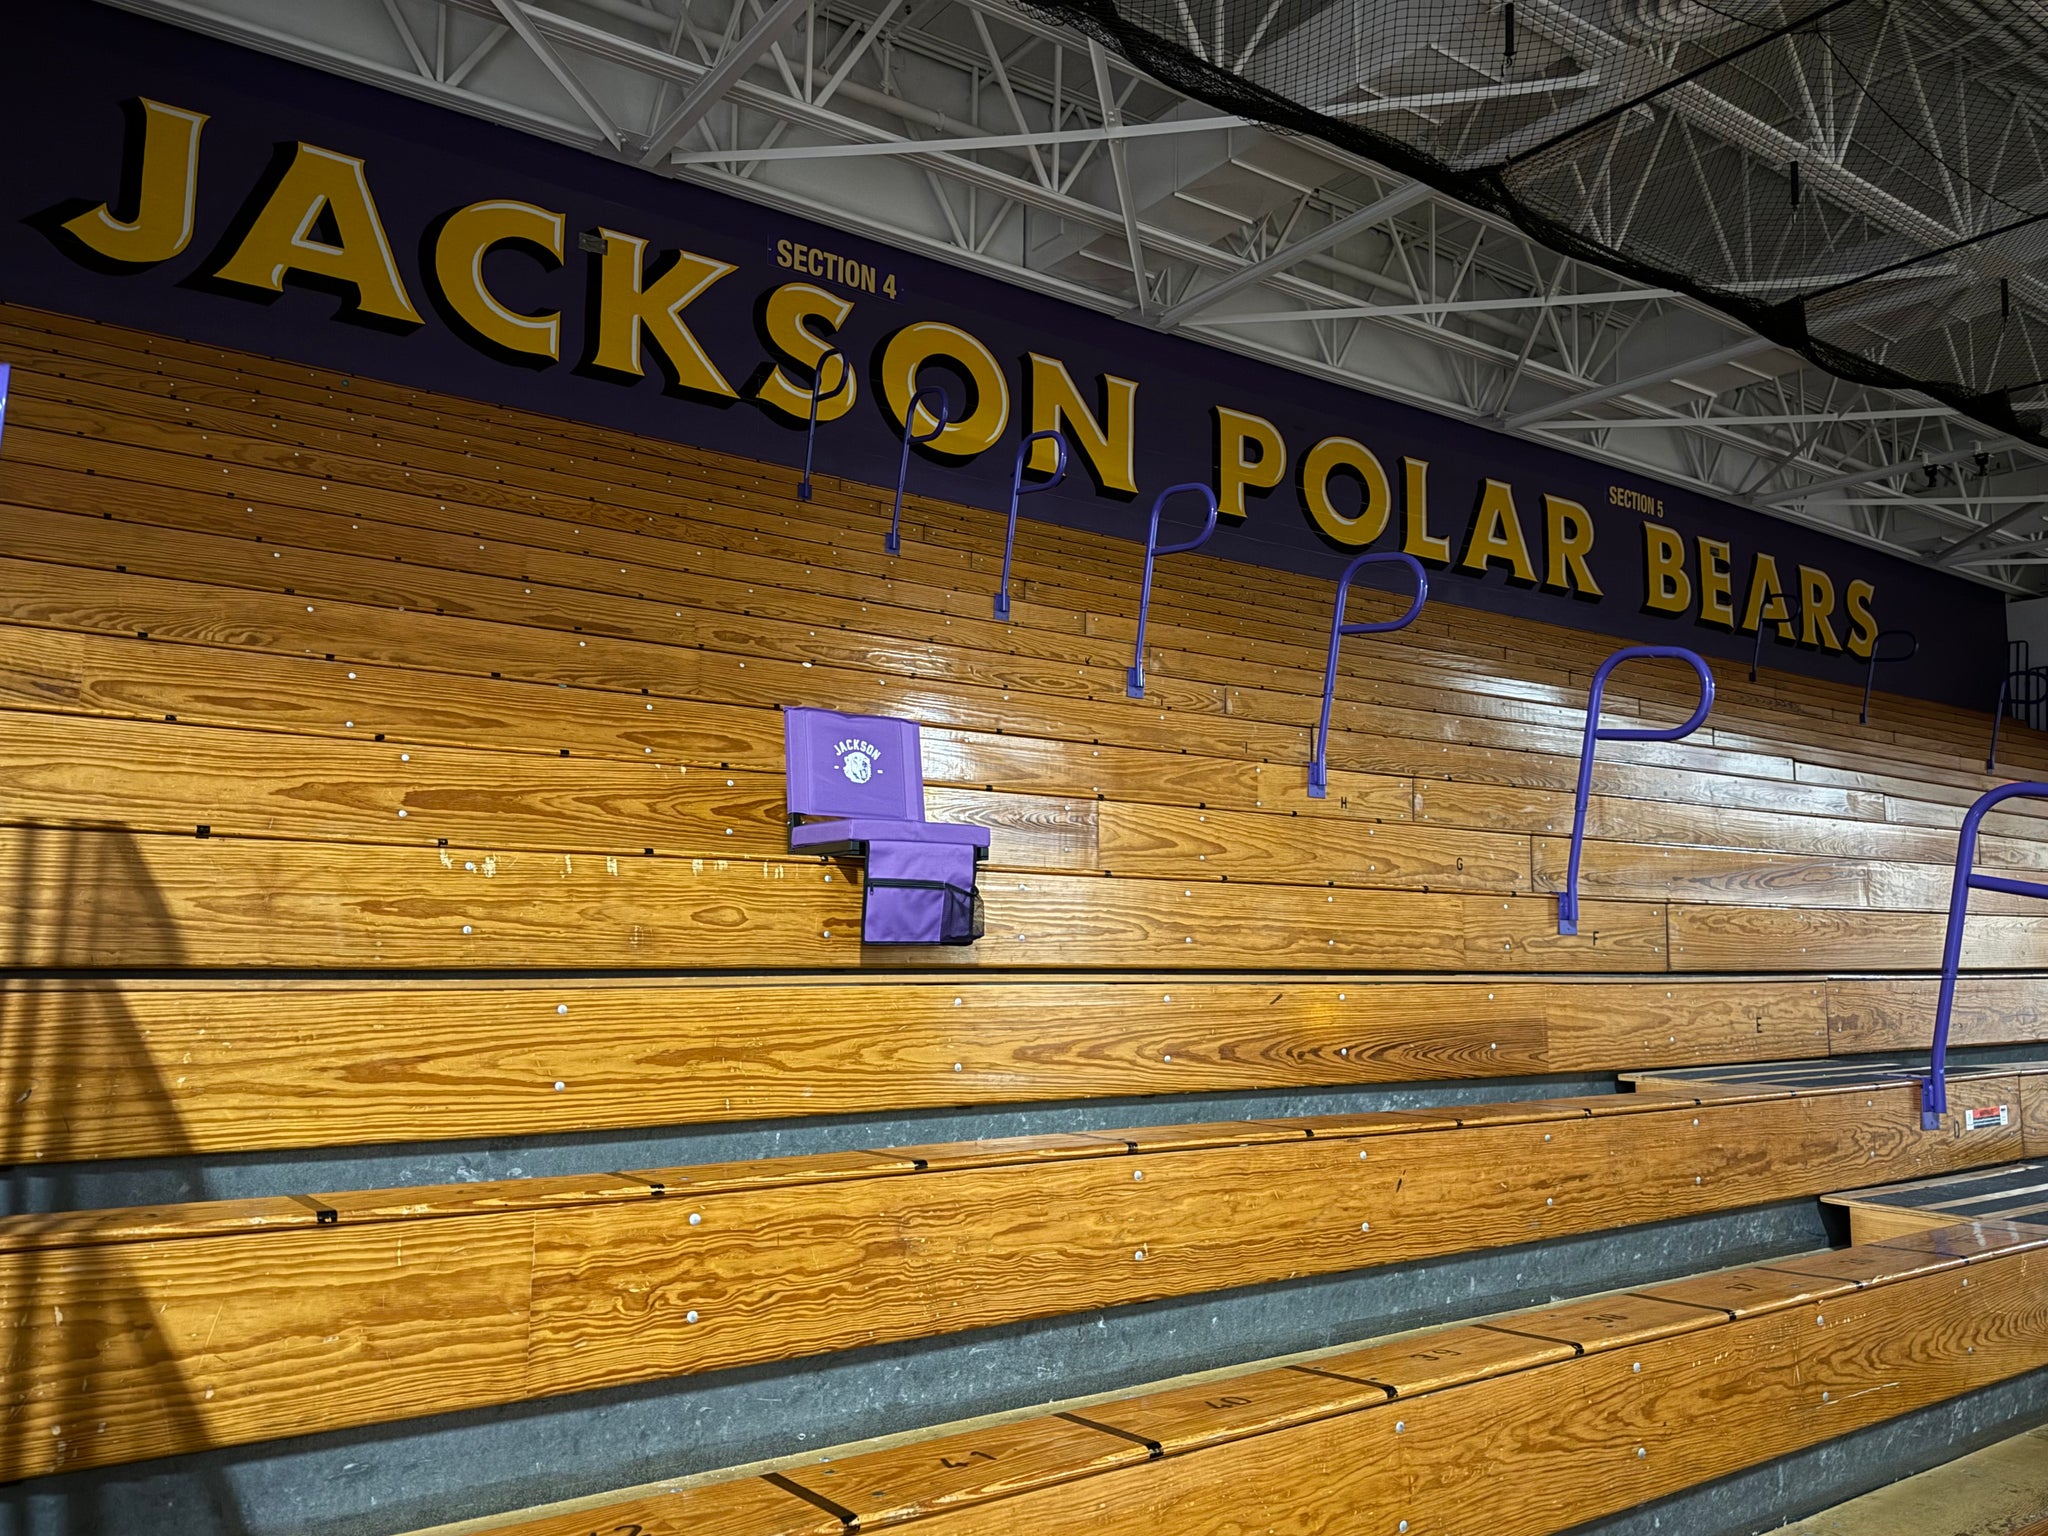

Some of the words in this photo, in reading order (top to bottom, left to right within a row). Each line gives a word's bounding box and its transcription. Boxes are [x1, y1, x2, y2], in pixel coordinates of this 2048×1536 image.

[776, 239, 876, 294] SECTION
[883, 273, 897, 300] 4
[61, 96, 1139, 494] JACKSON
[1215, 405, 1605, 597] POLAR
[1642, 520, 1880, 659] BEARS
[1609, 485, 1655, 516] SECTION
[1657, 500, 1664, 518] 5
[833, 738, 882, 761] JACKSON
[1340, 796, 1348, 809] H
[1456, 857, 1464, 871] G
[1592, 931, 1600, 946] F
[1756, 1017, 1763, 1033] E
[1204, 1396, 1252, 1409] 40
[940, 1451, 997, 1468] 41
